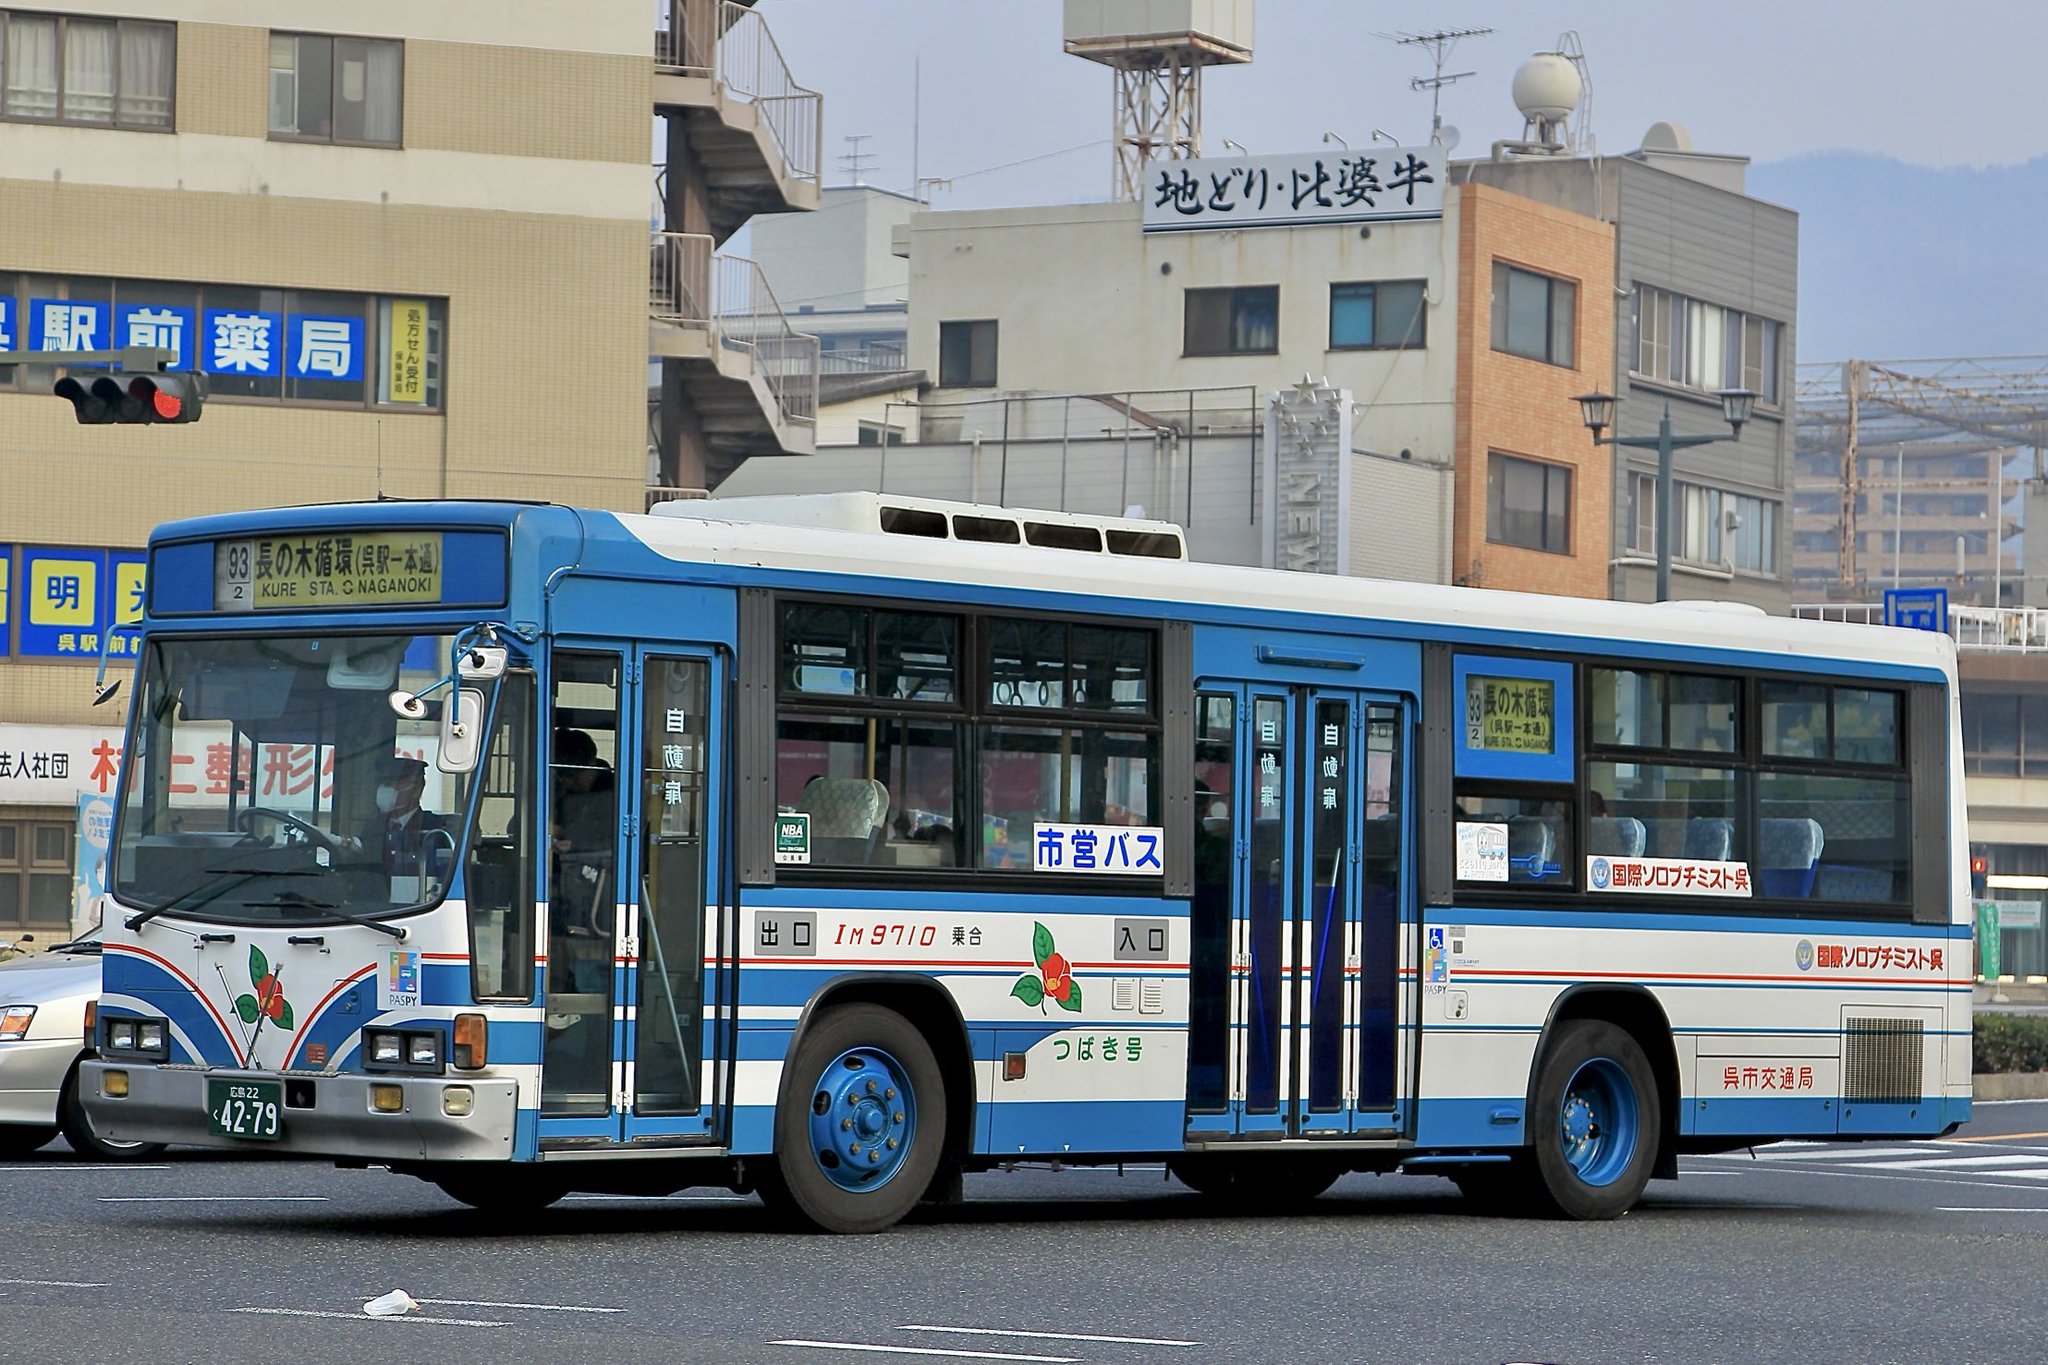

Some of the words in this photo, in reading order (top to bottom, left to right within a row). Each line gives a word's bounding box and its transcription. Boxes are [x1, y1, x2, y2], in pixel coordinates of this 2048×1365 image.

[406, 309, 420, 393] 処方せん受付
[229, 546, 249, 579] 93
[233, 586, 243, 599] 2
[262, 582, 297, 597] KURE
[309, 581, 338, 596] STA.
[358, 577, 431, 595] NAGANOKI
[1471, 728, 1480, 740] 2
[0, 751, 68, 779] 法人社団
[781, 824, 803, 837] NBA
[1037, 828, 1161, 868] 市営バス
[1612, 864, 1749, 890] 国際ソロプチミスト呉
[761, 920, 810, 946] 出口
[952, 926, 982, 946] 乗合
[1119, 926, 1164, 951] 入口
[1817, 945, 1943, 971] 国際ソロプチミスト呉
[390, 994, 417, 1006] PASPY
[1425, 985, 1447, 994] PASPY
[1053, 1036, 1143, 1062] つばき号
[1723, 1066, 1814, 1091] 呉市交通局
